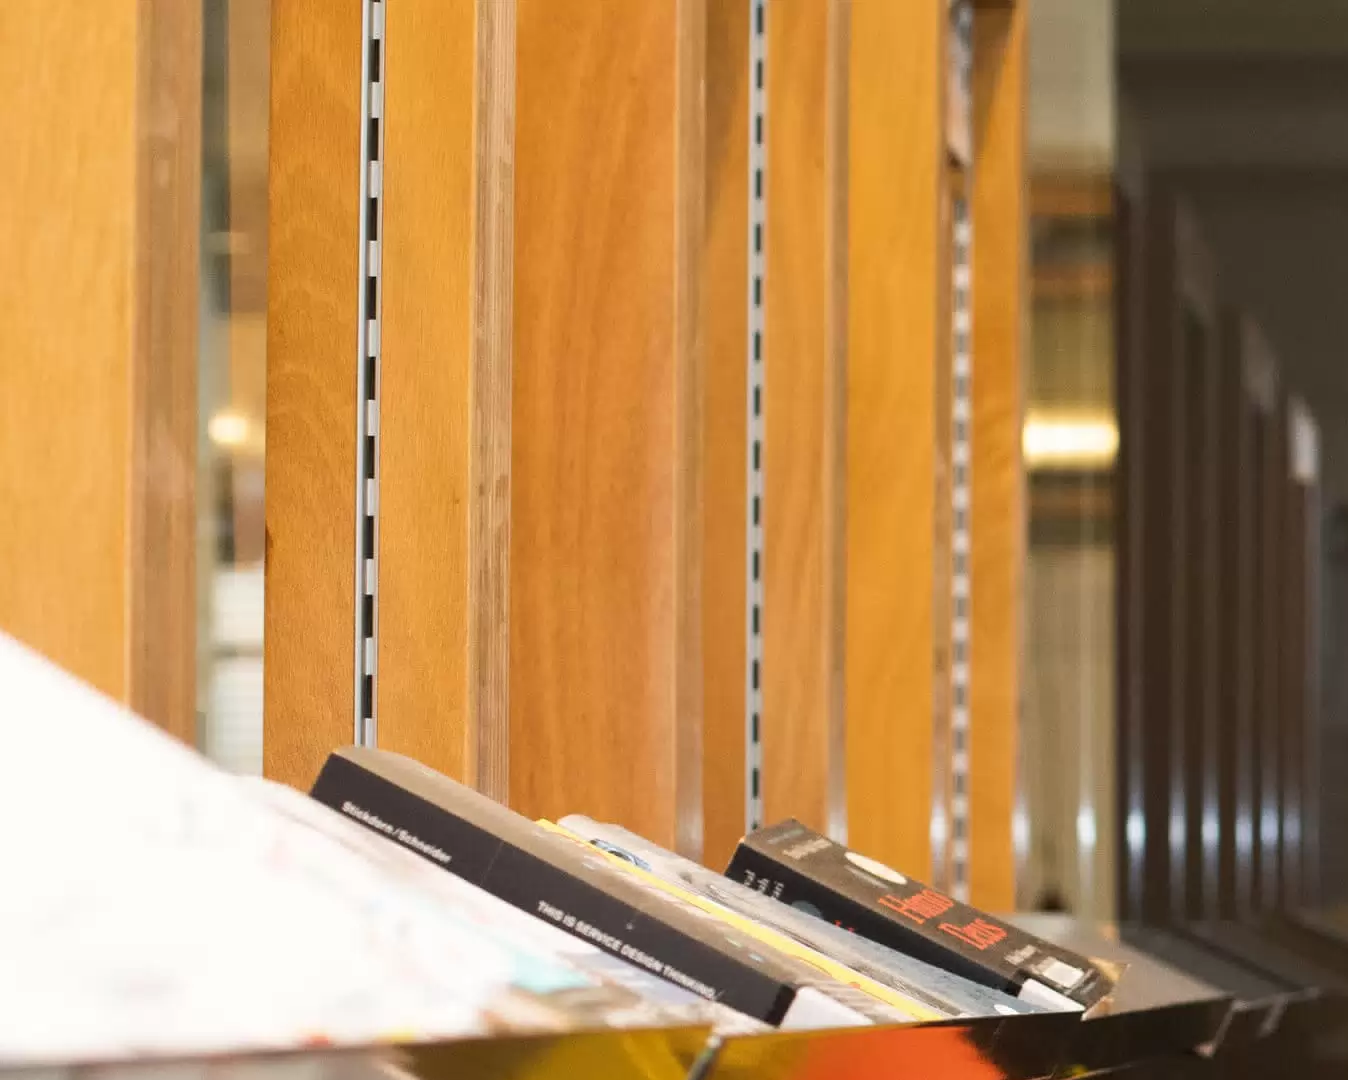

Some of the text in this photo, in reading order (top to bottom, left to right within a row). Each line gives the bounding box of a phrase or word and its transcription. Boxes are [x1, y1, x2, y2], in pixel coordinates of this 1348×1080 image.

[538, 900, 565, 922] THIS
[563, 914, 577, 929] IS
[575, 921, 623, 952] SERVICE
[620, 944, 665, 973] DESIGN
